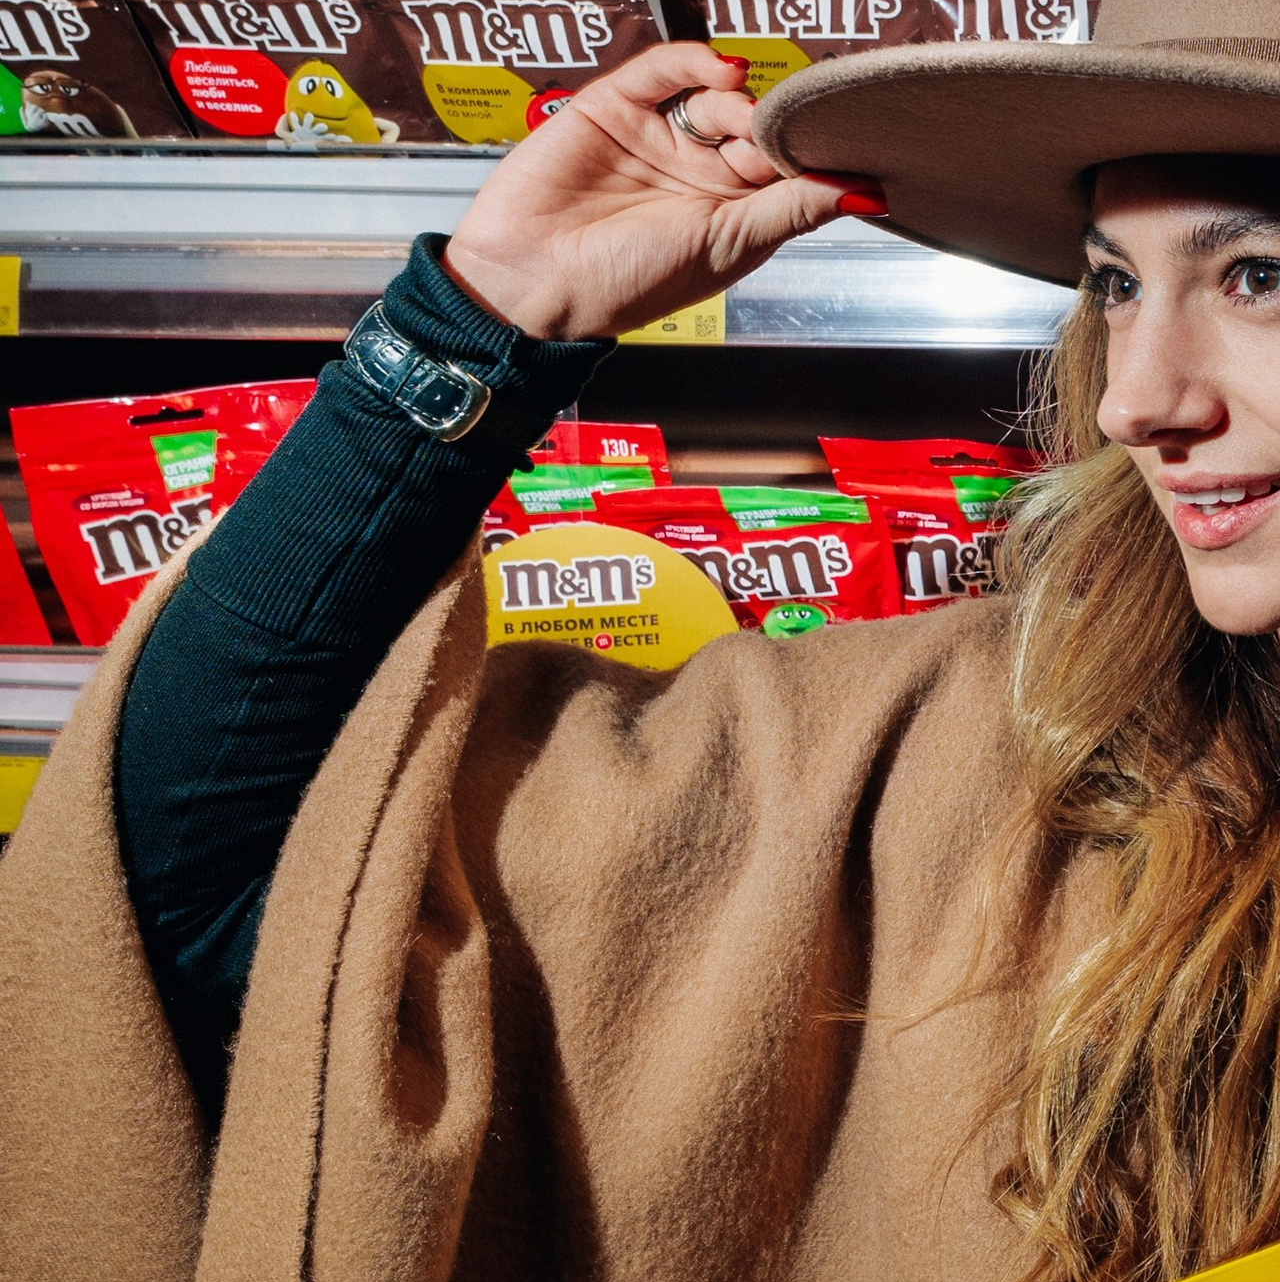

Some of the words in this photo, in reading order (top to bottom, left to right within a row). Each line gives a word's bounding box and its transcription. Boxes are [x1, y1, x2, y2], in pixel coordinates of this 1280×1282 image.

[184, 61, 238, 74] Любишь
[187, 76, 259, 90] веселиться,
[191, 88, 227, 99] люби
[447, 86, 511, 97] компании
[205, 101, 263, 113] веселись
[504, 623, 514, 634] В
[520, 618, 594, 634] ЛЮБОМ
[600, 614, 660, 629] МЕСТЕ
